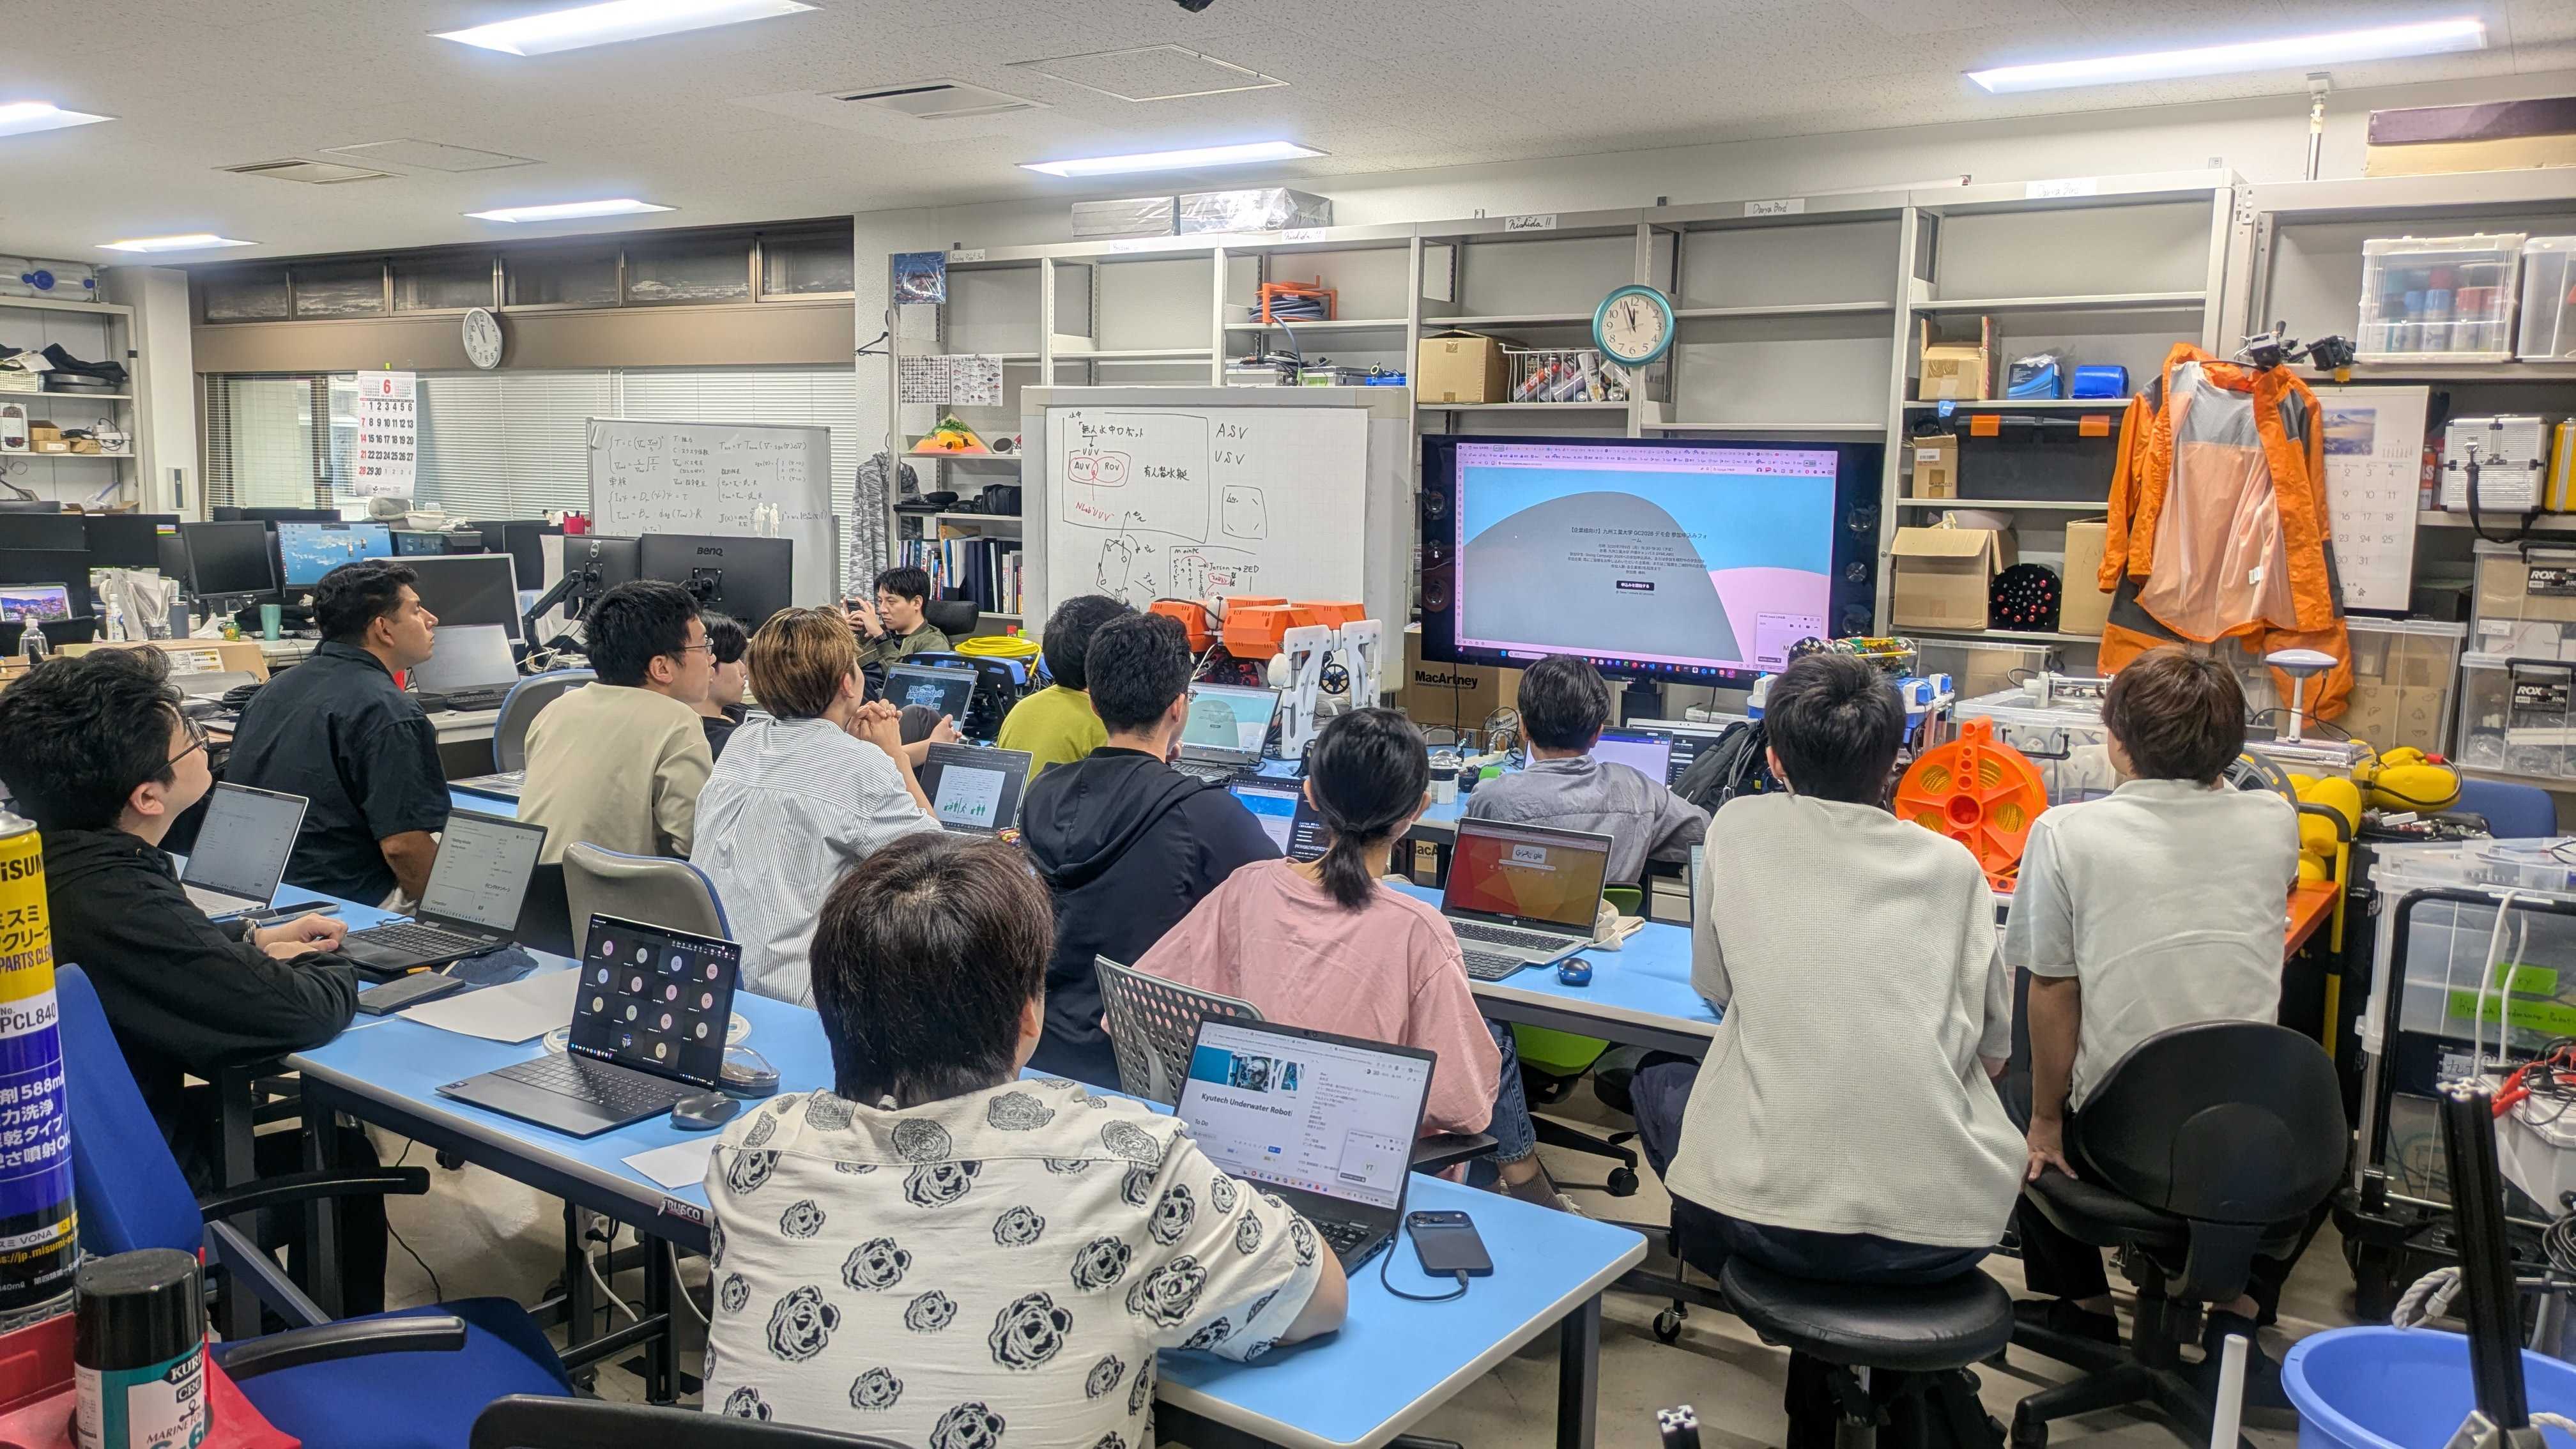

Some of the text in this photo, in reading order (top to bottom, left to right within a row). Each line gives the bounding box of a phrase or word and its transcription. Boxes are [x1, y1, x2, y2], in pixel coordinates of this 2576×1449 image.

[1631, 296, 1639, 306] 12
[1609, 310, 1618, 318] 10
[1652, 309, 1659, 318] 2
[1607, 321, 1613, 330] 9
[1655, 322, 1662, 331] 3
[1609, 334, 1616, 342] 8
[1618, 343, 1625, 351] 7
[1642, 343, 1648, 351] 5
[383, 379, 391, 394] 6
[377, 402, 381, 410] 2
[392, 402, 397, 411] 4
[408, 403, 412, 411] 6
[361, 418, 413, 428] 7 8 9 10 11 12 13
[1216, 423, 1249, 439] ASV
[360, 434, 413, 445] 14 15 16 17 18 19 20
[360, 450, 413, 461] 21 22 23 24 25 26 27
[1215, 450, 1245, 464] USV
[359, 466, 381, 475] 28 29 30
[1074, 461, 1120, 470] AUV ROV
[2344, 468, 2350, 477] 2
[2366, 469, 2372, 477] 3
[2342, 512, 2350, 521] 16
[2338, 534, 2349, 542] 23
[697, 547, 723, 556] BenQ
[2358, 556, 2368, 565] 31
[2531, 570, 2556, 580] ROX
[1415, 670, 1478, 689] MacArtney
[2517, 686, 2543, 696] ROX
[1, 1006, 16, 1016] No.
[0, 1001, 56, 1034] PCL840
[1201, 1092, 1229, 1105] Kyutech
[1229, 1098, 1269, 1112] Underwater
[0, 1098, 54, 1126] 力洗浄
[20, 1230, 52, 1245] VONA
[147, 1420, 188, 1445] MARINE
